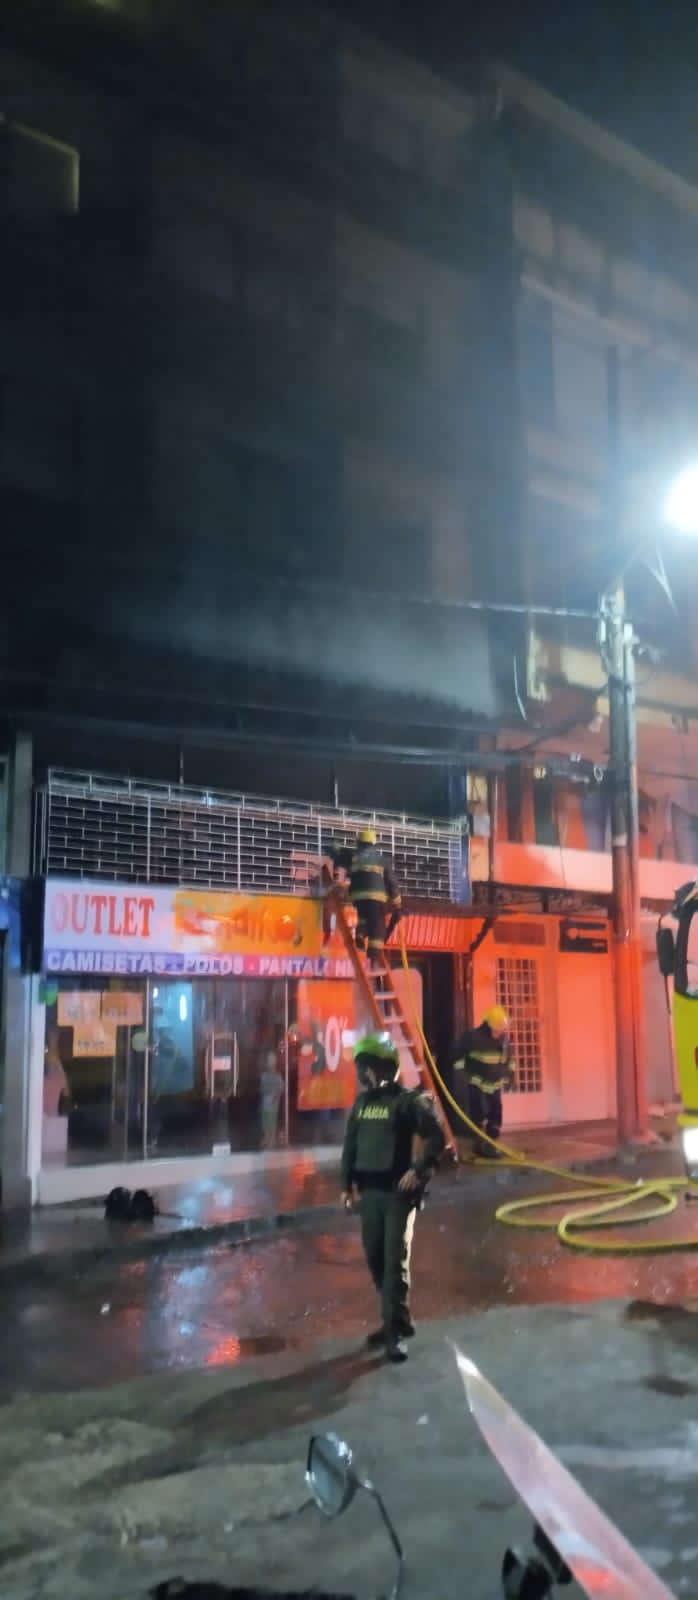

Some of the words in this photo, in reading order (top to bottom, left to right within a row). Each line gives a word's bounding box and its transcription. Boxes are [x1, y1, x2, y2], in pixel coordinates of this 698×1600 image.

[51, 893, 155, 937] OUTLET
[47, 951, 167, 975] CAMISETAS
[183, 954, 244, 976] POLOS
